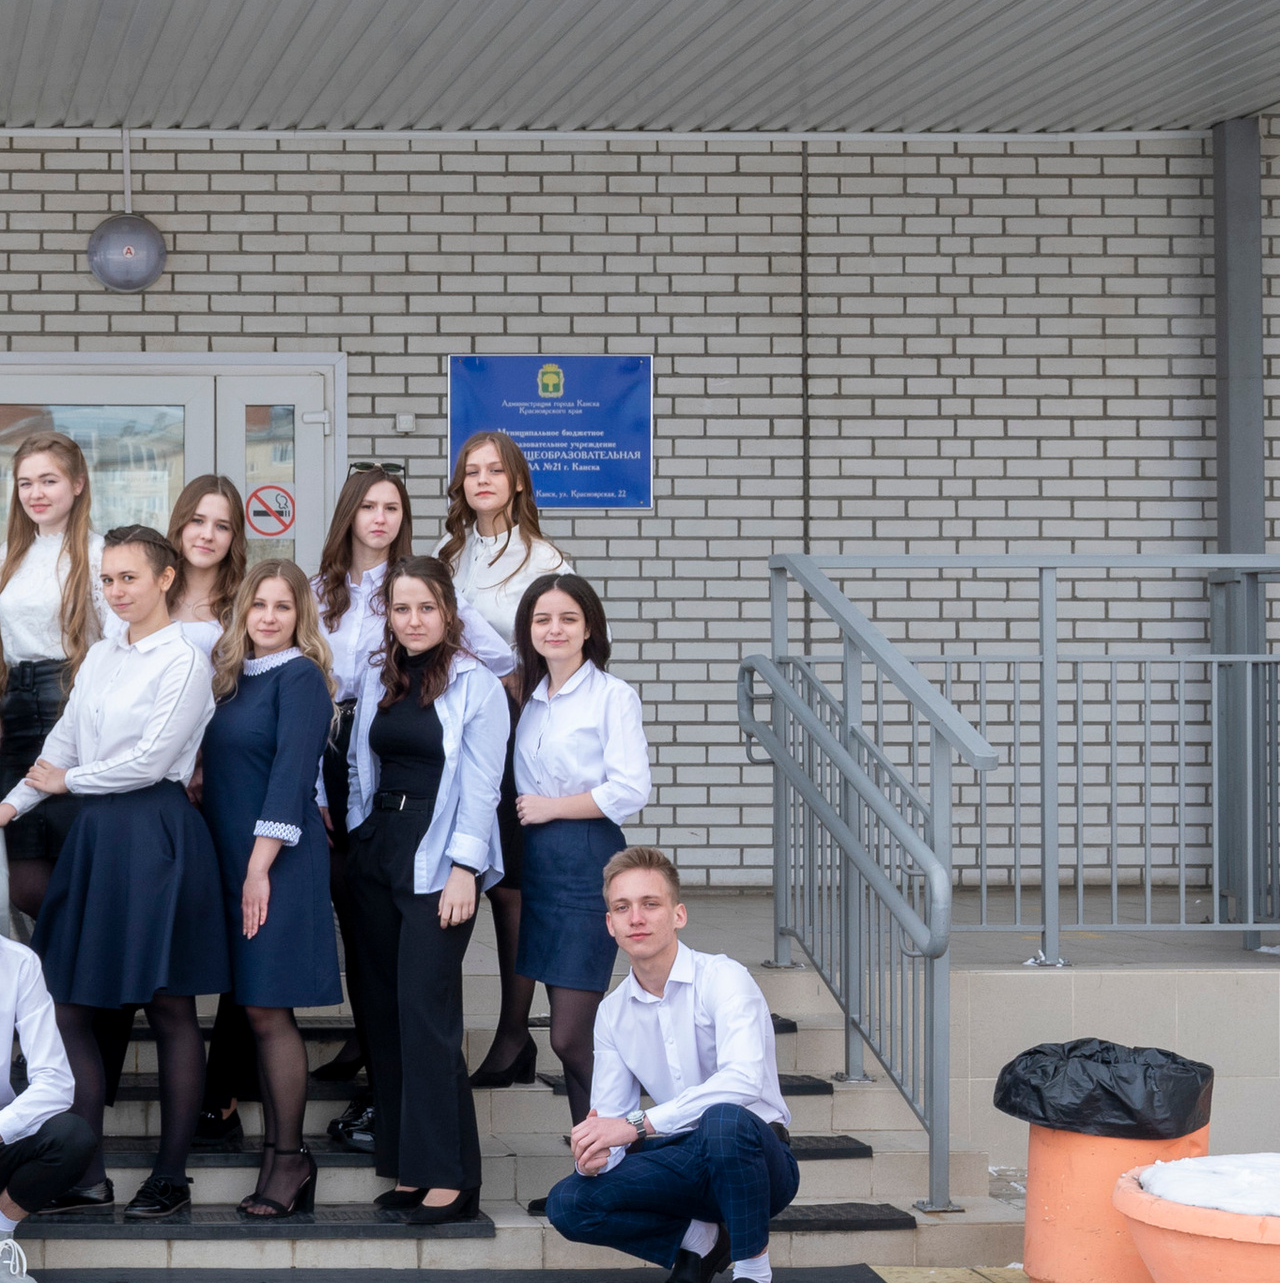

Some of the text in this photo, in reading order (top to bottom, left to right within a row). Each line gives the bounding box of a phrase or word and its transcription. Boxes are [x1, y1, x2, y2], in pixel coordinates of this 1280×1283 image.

[501, 399, 551, 408] Администрация
[576, 399, 600, 407] Канска
[519, 407, 566, 415] Красноярского
[561, 429, 605, 437] бюджетное
[570, 441, 617, 449] учреждение
[523, 450, 641, 461] ЩЕОБРАЗОВАТЕЛЬНАЯ
[542, 462, 562, 471] №21
[572, 462, 600, 471] Канска
[618, 489, 626, 497] 22
